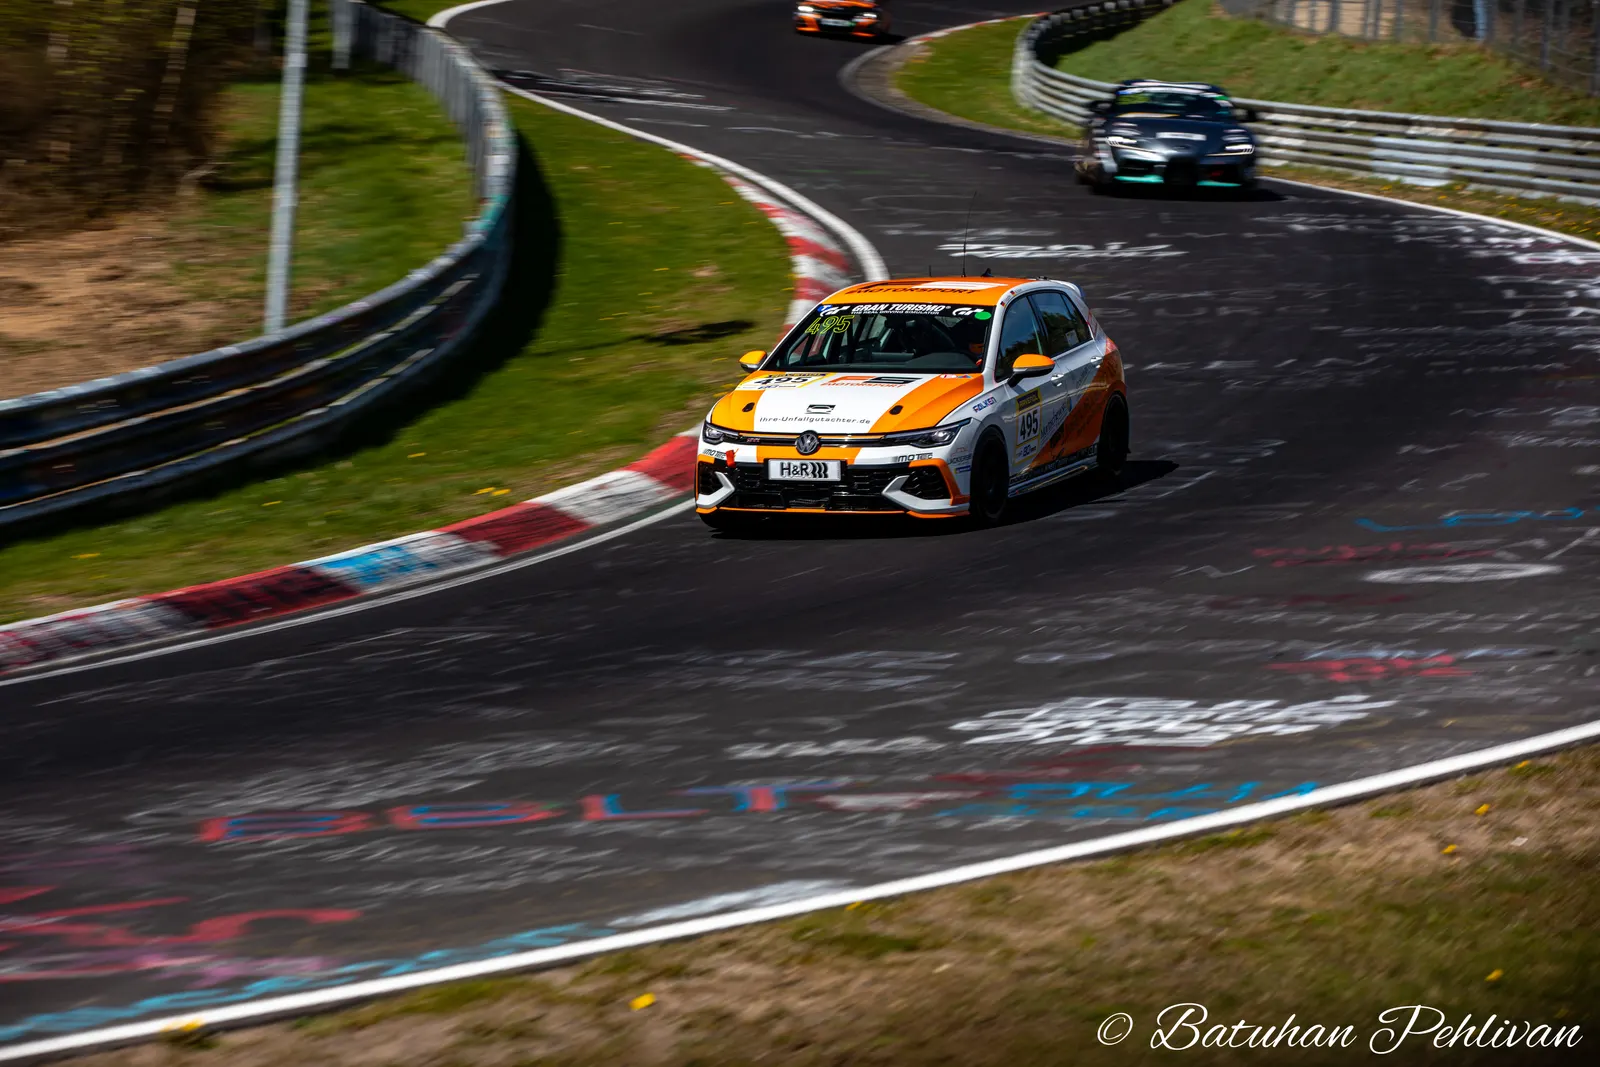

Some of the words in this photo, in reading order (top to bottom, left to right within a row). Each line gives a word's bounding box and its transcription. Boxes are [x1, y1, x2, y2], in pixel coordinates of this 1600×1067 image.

[852, 303, 890, 312] GRAN
[805, 315, 854, 335] 495
[754, 376, 809, 385] 495
[972, 396, 997, 413] FALKEN
[759, 416, 871, 425] Ihre-Unfallgutachter.de
[1019, 409, 1039, 440] 495
[780, 461, 809, 477] H&R
